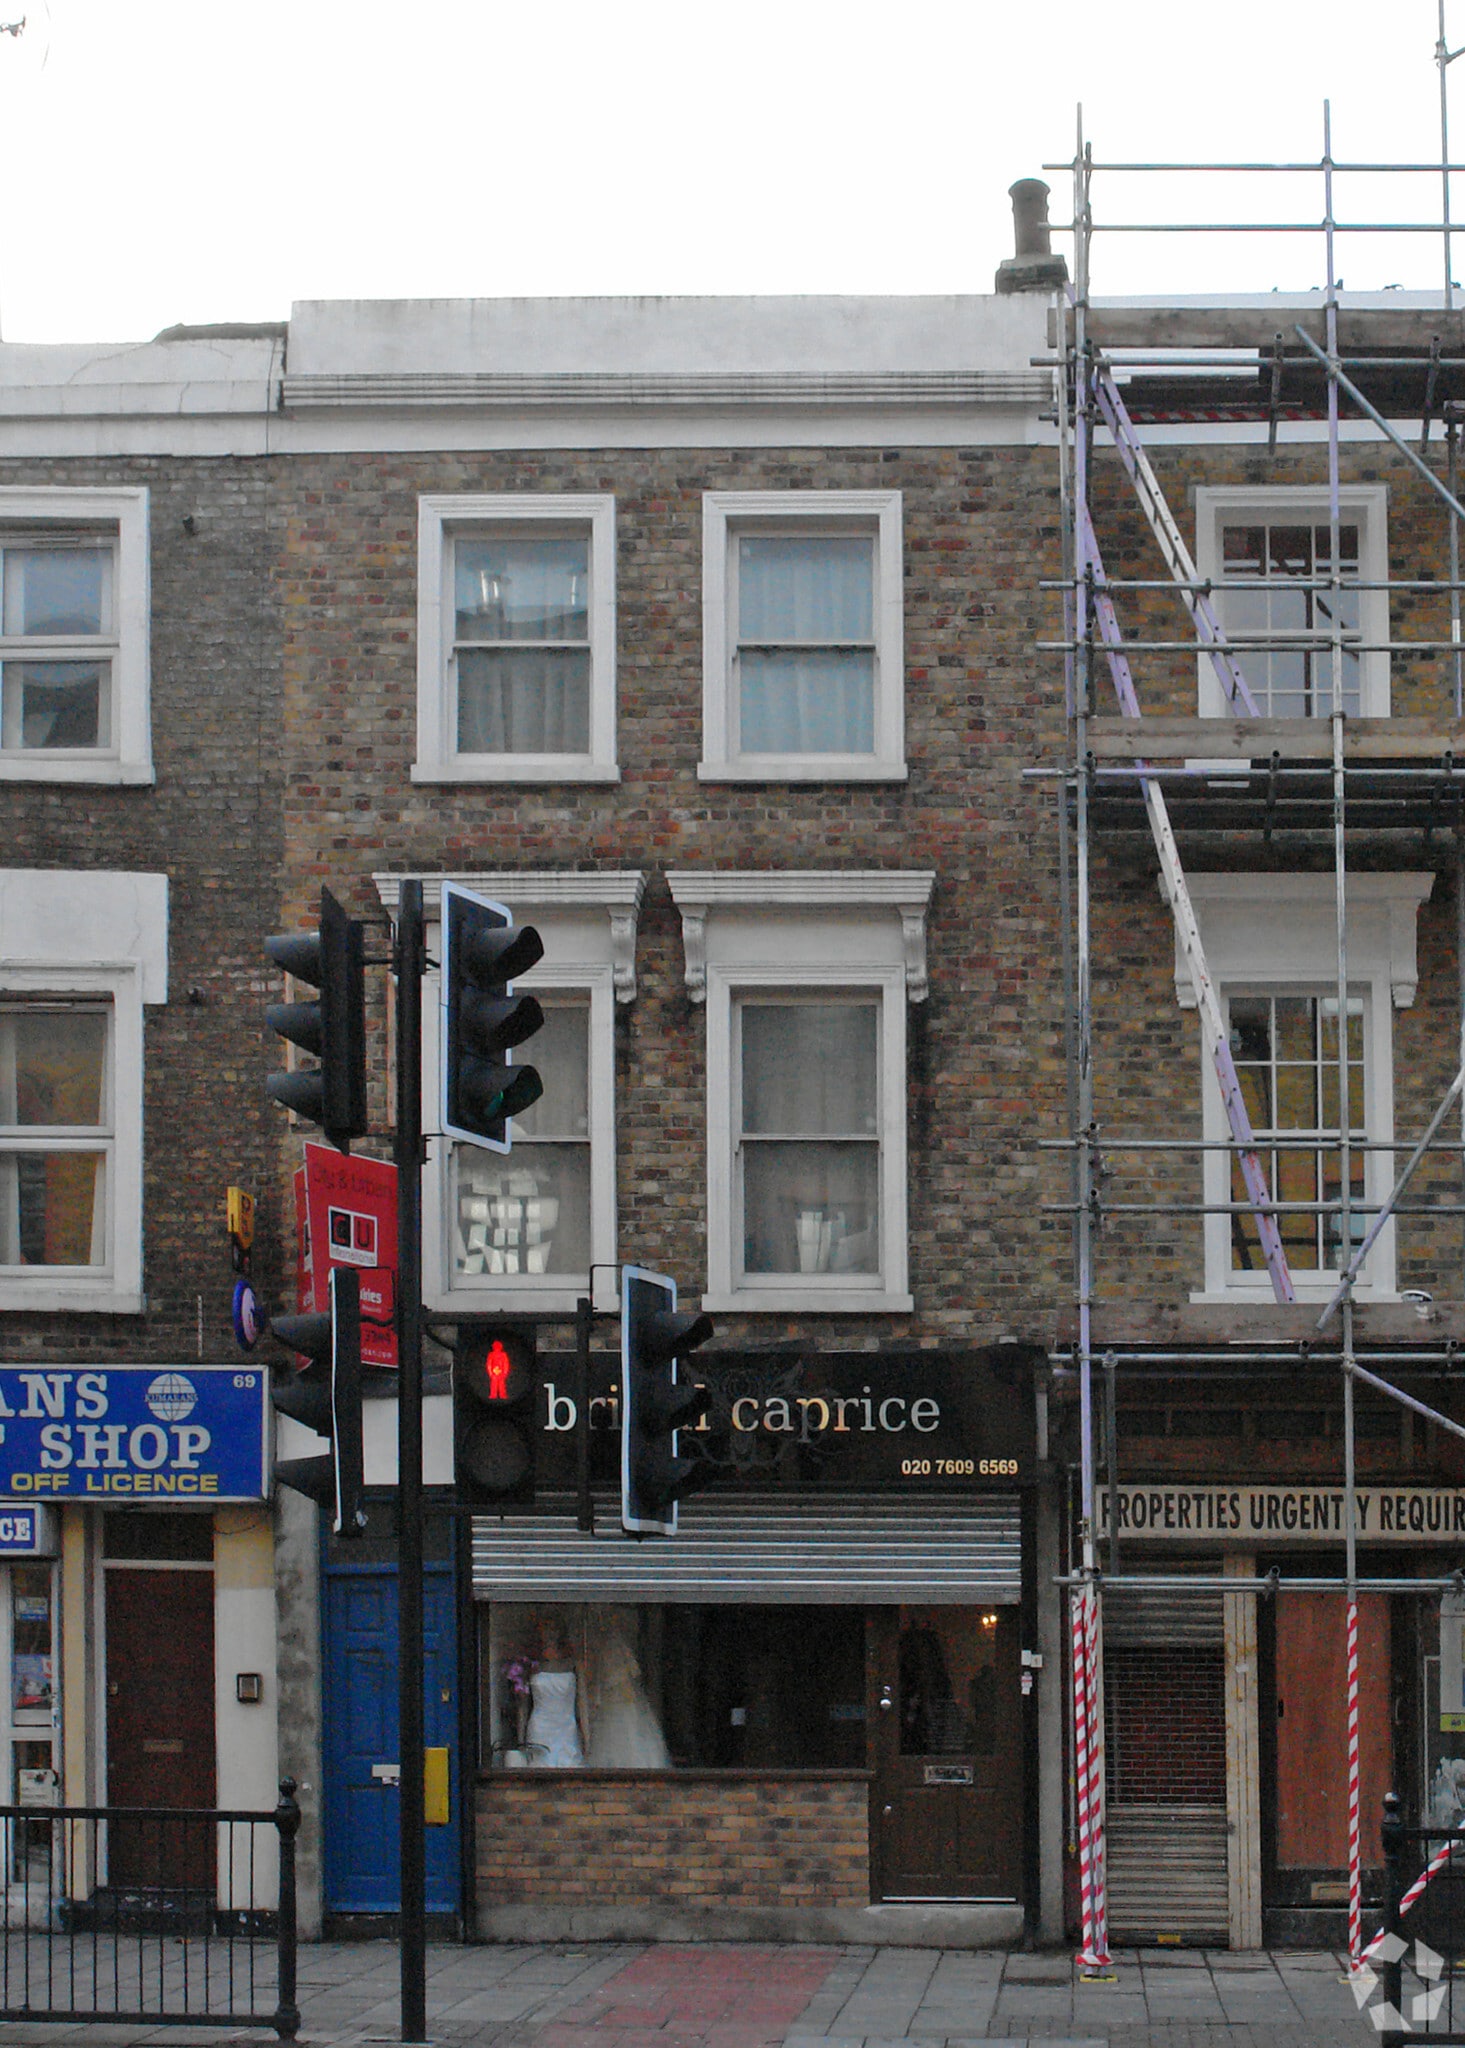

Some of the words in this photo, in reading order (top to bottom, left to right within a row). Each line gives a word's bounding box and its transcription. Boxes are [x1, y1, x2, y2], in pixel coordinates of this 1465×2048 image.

[233, 1374, 256, 1388] 69
[731, 1385, 941, 1443] caprice
[40, 1423, 211, 1470] SHOP
[901, 1459, 931, 1475] 020
[936, 1459, 974, 1475] 7609
[979, 1459, 1018, 1475] 6569
[10, 1473, 70, 1491] OFF
[86, 1473, 219, 1492] LICENCE
[1250, 1493, 1370, 1530] URGENTY
